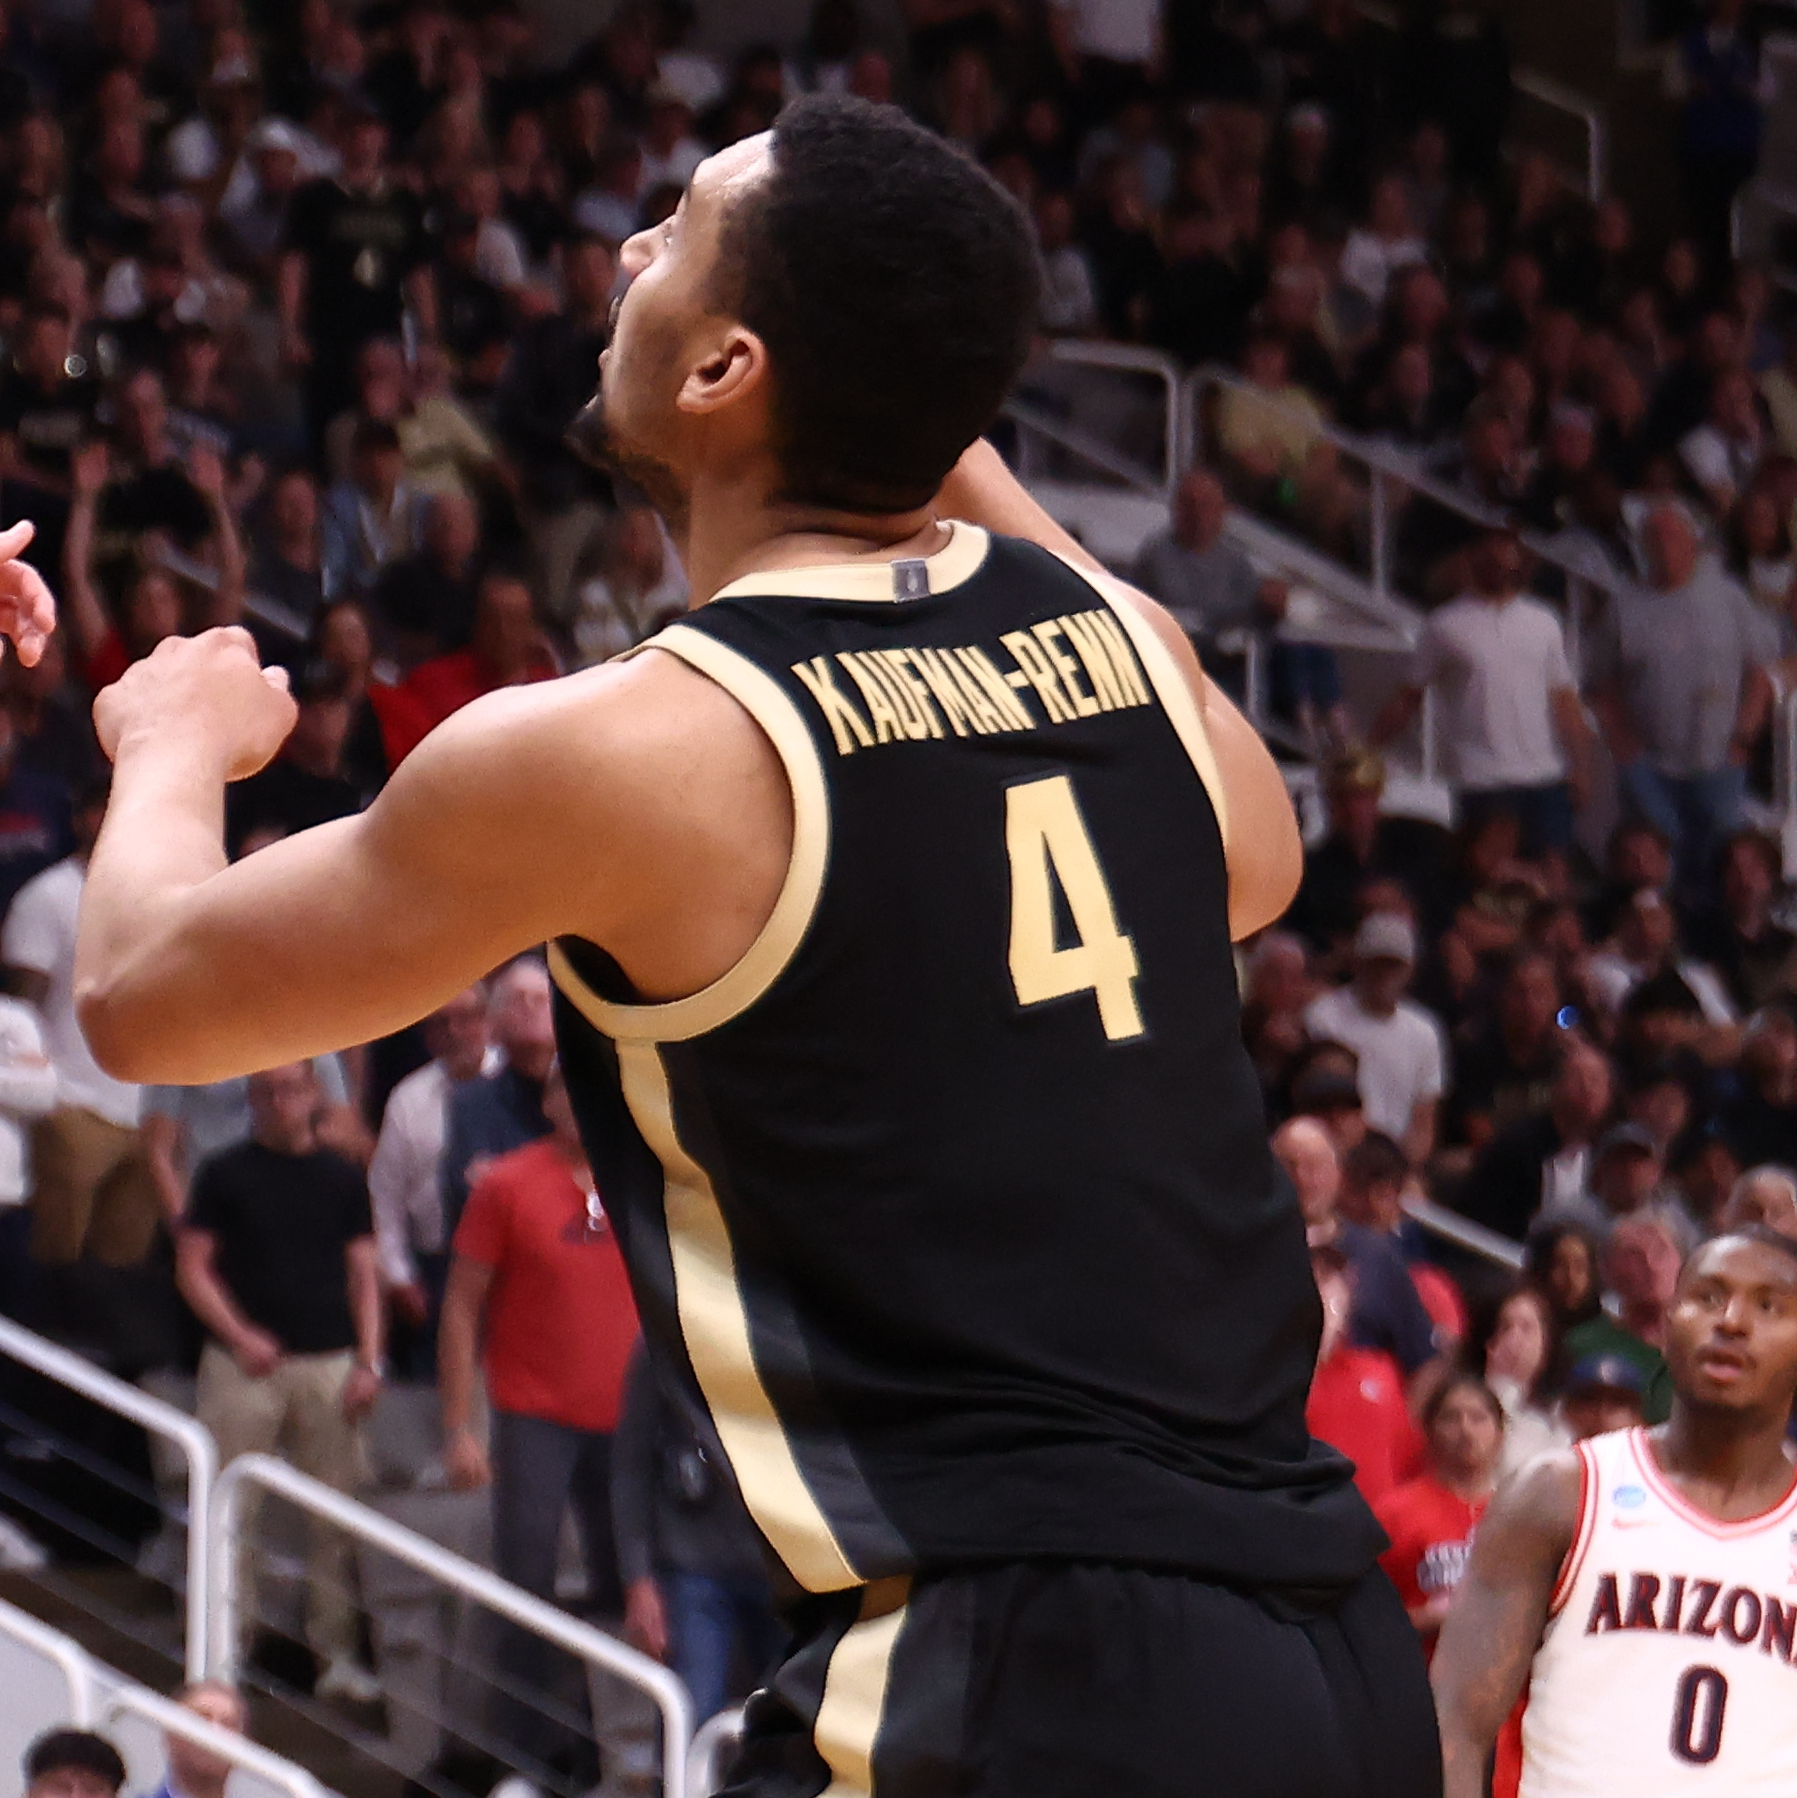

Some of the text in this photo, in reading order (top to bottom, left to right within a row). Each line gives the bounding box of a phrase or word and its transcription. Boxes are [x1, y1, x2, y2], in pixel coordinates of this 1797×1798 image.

[790, 607, 1152, 757] KAUFMAN-RENN
[1005, 774, 1145, 1042] 4
[1584, 1571, 1797, 1668] ARIZON
[1668, 1663, 1729, 1769] 0
